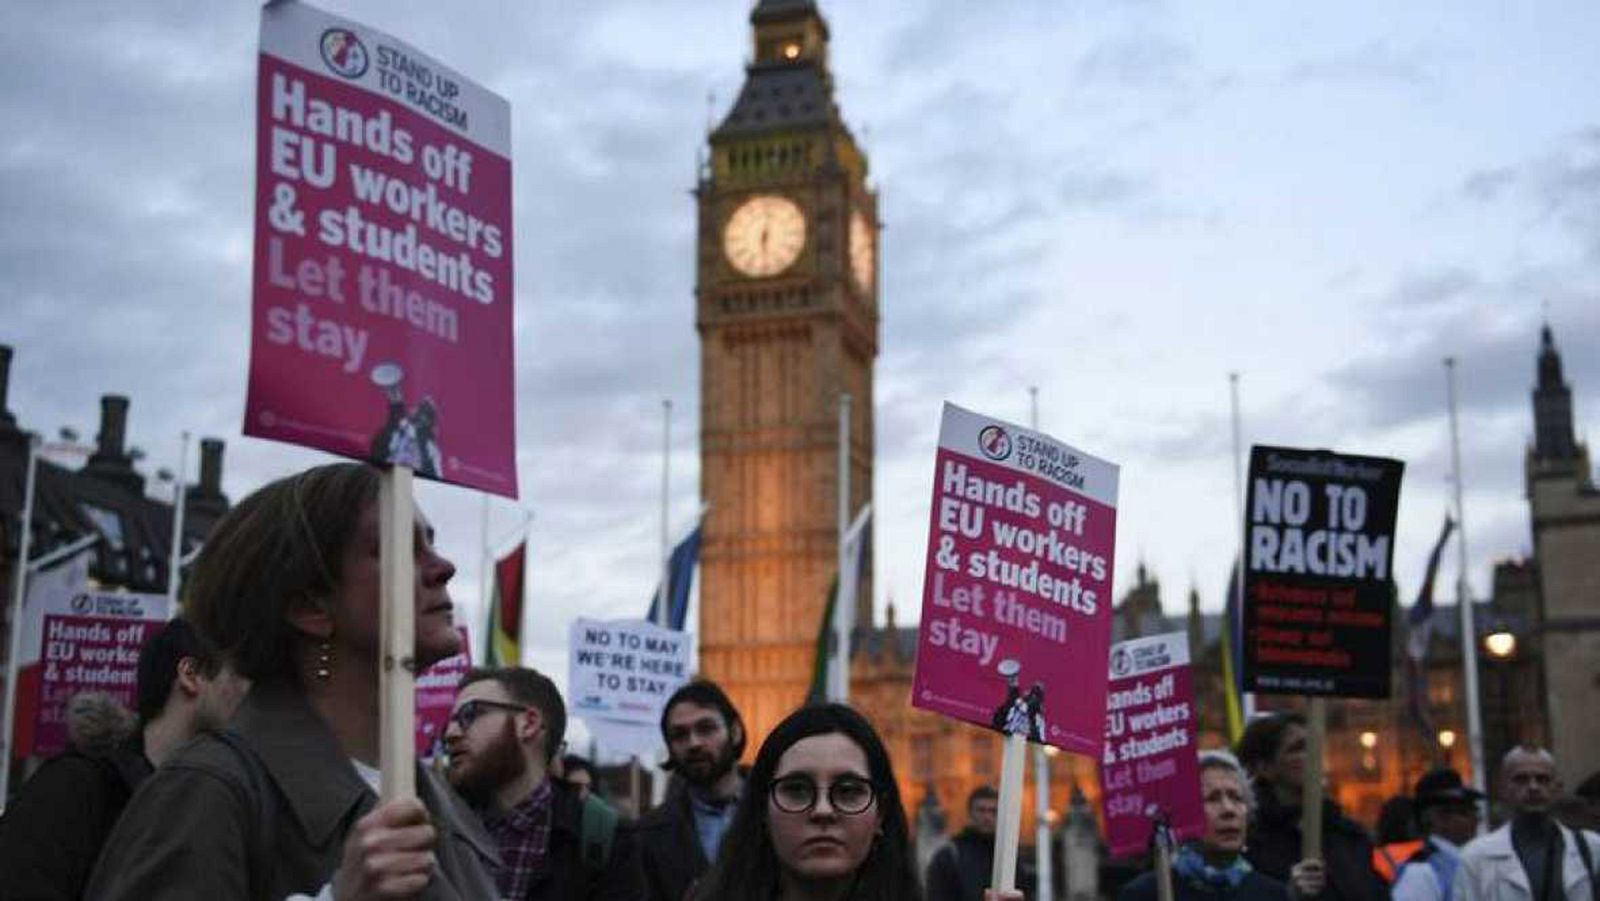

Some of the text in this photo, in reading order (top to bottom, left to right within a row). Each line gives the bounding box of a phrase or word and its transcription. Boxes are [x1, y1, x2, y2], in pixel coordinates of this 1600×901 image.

[377, 44, 459, 98] STAND UP
[376, 67, 468, 131] TO RACISM
[271, 73, 473, 194] Hands off
[271, 125, 502, 258] EU workers
[268, 182, 494, 304] & students
[268, 239, 459, 344] Let them
[267, 303, 369, 374] stay
[1018, 435, 1080, 468] STAND UP
[1018, 451, 1085, 489] TO RACISM
[944, 460, 1087, 536] Hands off
[1253, 478, 1367, 532] NO TO
[939, 496, 1107, 580] EU workers
[1251, 525, 1390, 579] RACISM
[935, 534, 1097, 615] & students
[49, 620, 145, 643] Hands off
[933, 571, 1067, 644] Let them
[46, 640, 140, 664] EU worke
[576, 650, 684, 676] WE'RE HERE
[585, 628, 679, 654] NO TO MAY
[928, 616, 999, 666] stay
[43, 661, 138, 684] & studen
[597, 673, 667, 694] TO STAY
[1154, 674, 1174, 700] off
[1120, 727, 1189, 760] students
[1128, 702, 1189, 733] workers
